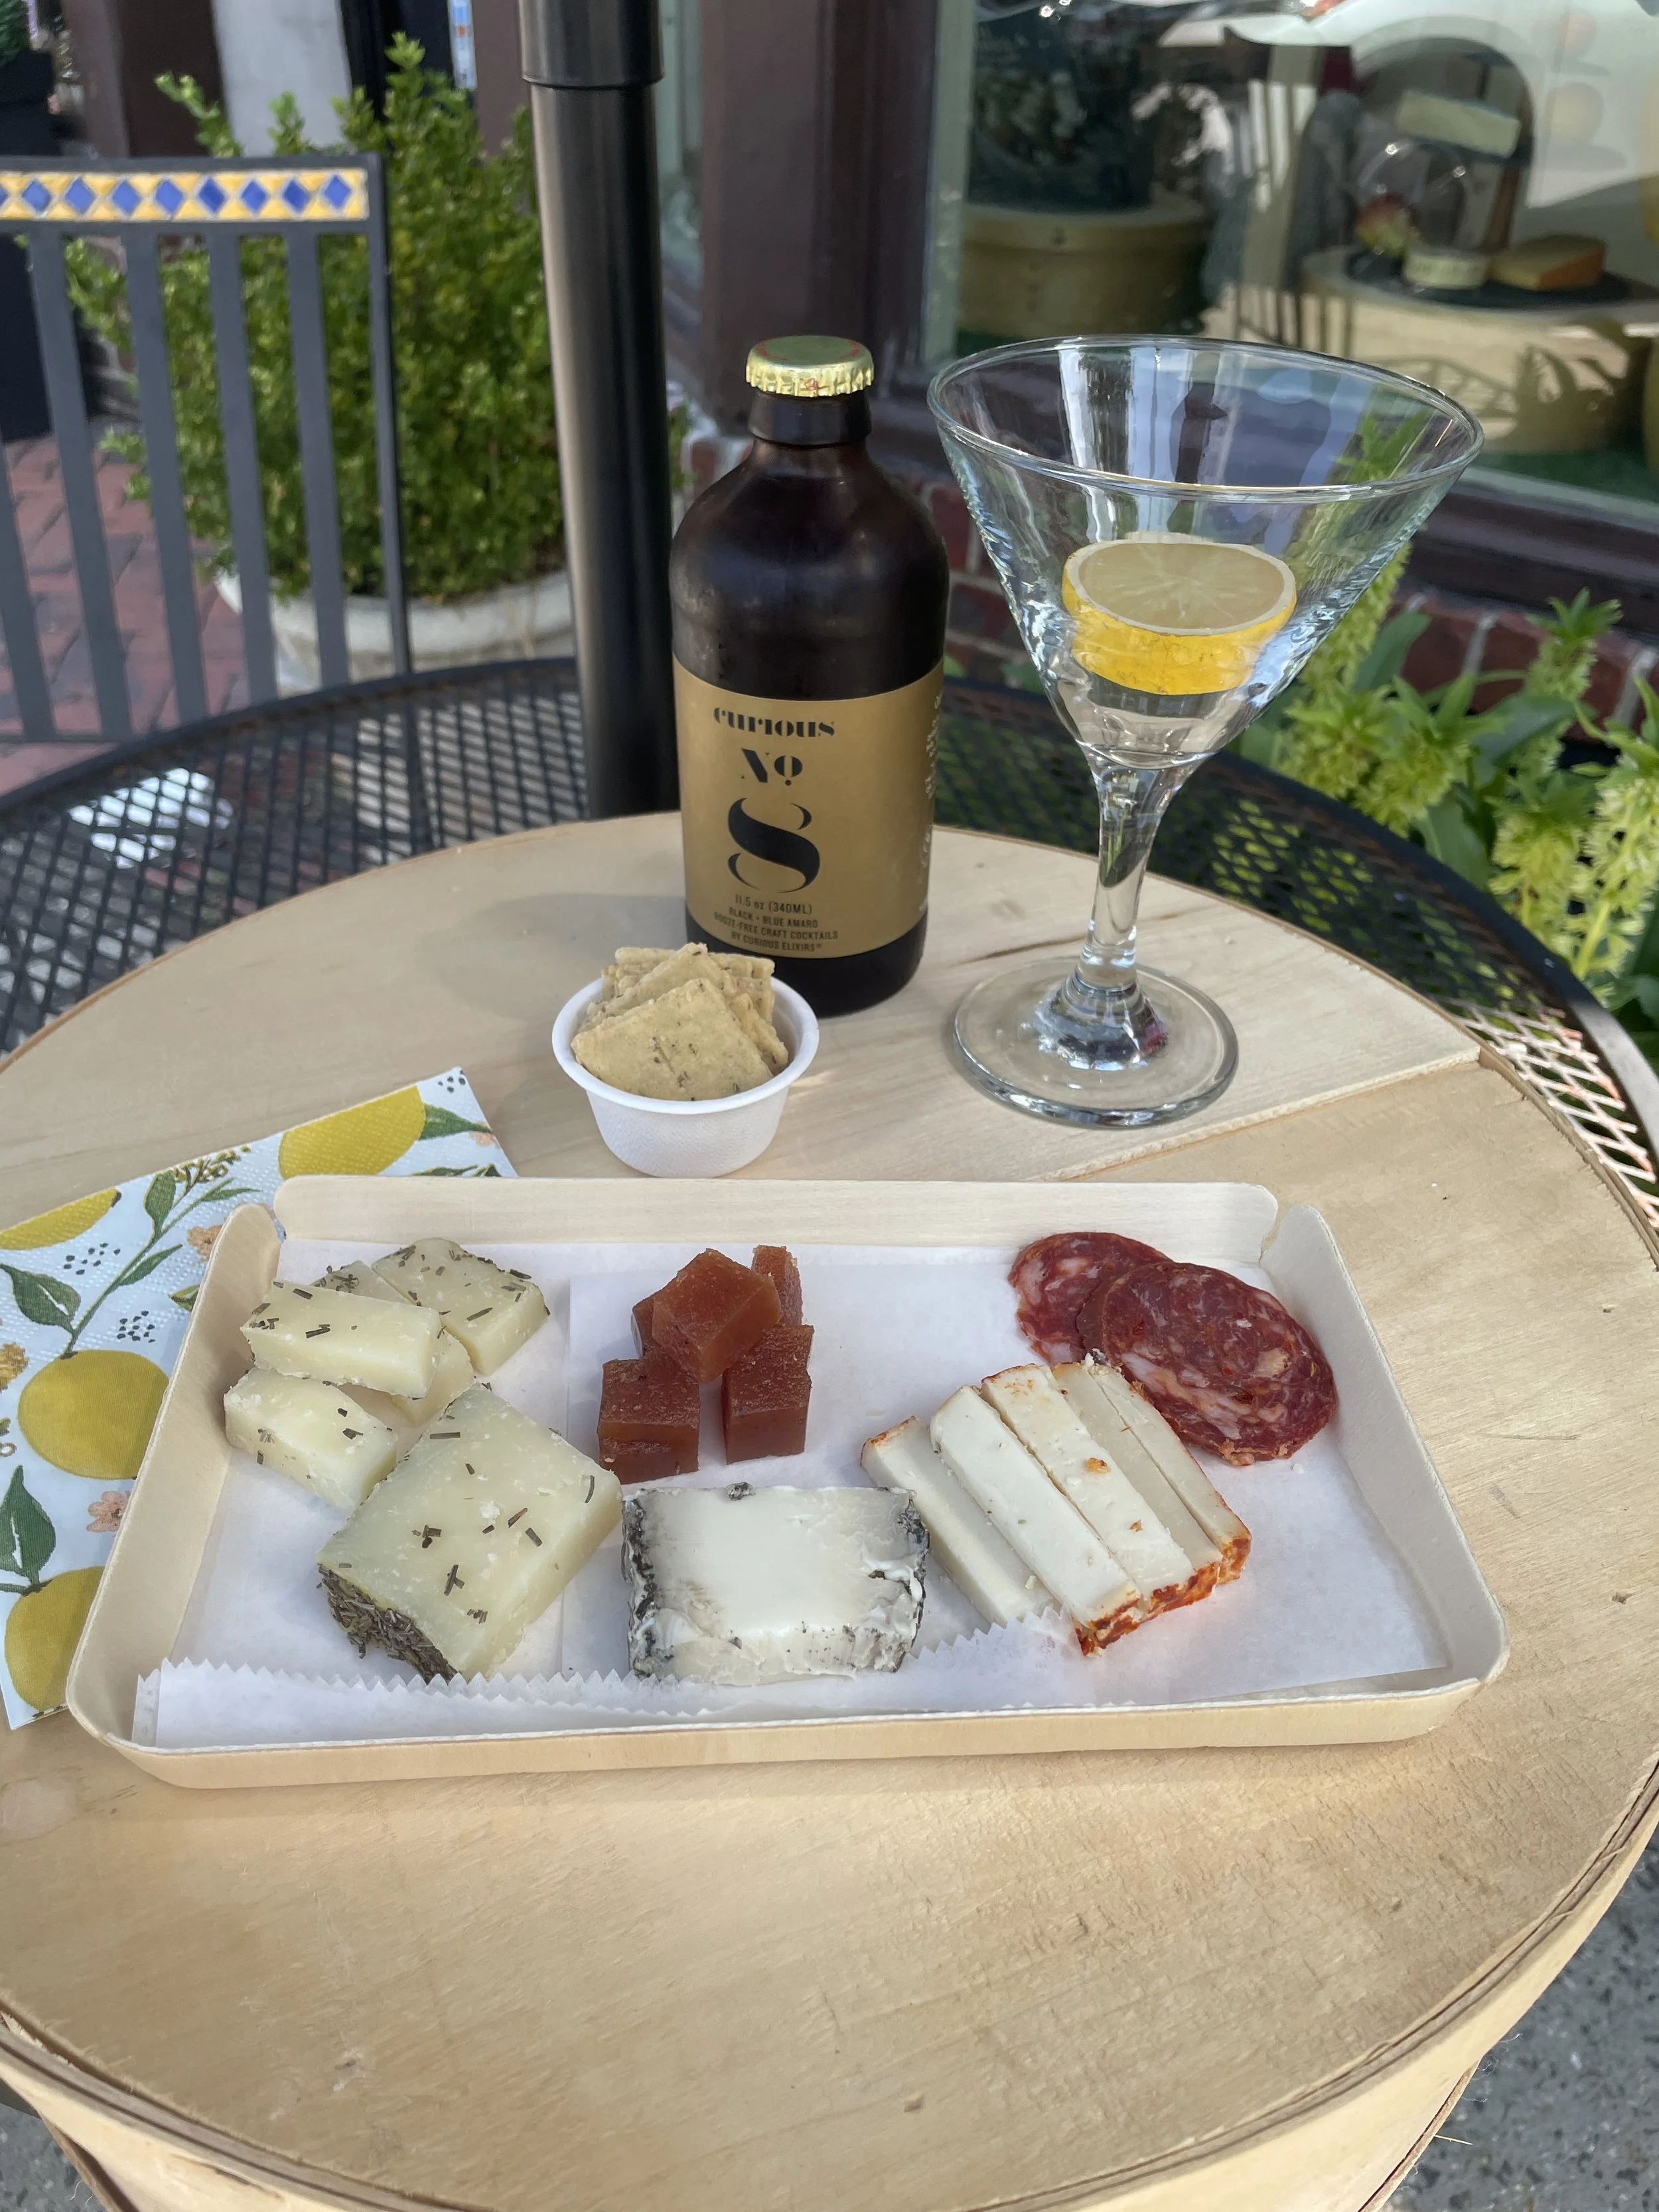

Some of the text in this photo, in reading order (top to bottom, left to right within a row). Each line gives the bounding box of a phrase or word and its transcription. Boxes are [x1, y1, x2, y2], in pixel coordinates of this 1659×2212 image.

[714, 707, 835, 737] curious
[727, 798, 820, 893] 8
[729, 907, 818, 928] BLACK BLUE AMARO
[768, 900, 812, 916] (340ML)
[731, 931, 741, 940] BY
[743, 934, 779, 950] CURIOUS
[761, 927, 787, 939] CRAFT
[790, 930, 838, 940] COCKTAILS
